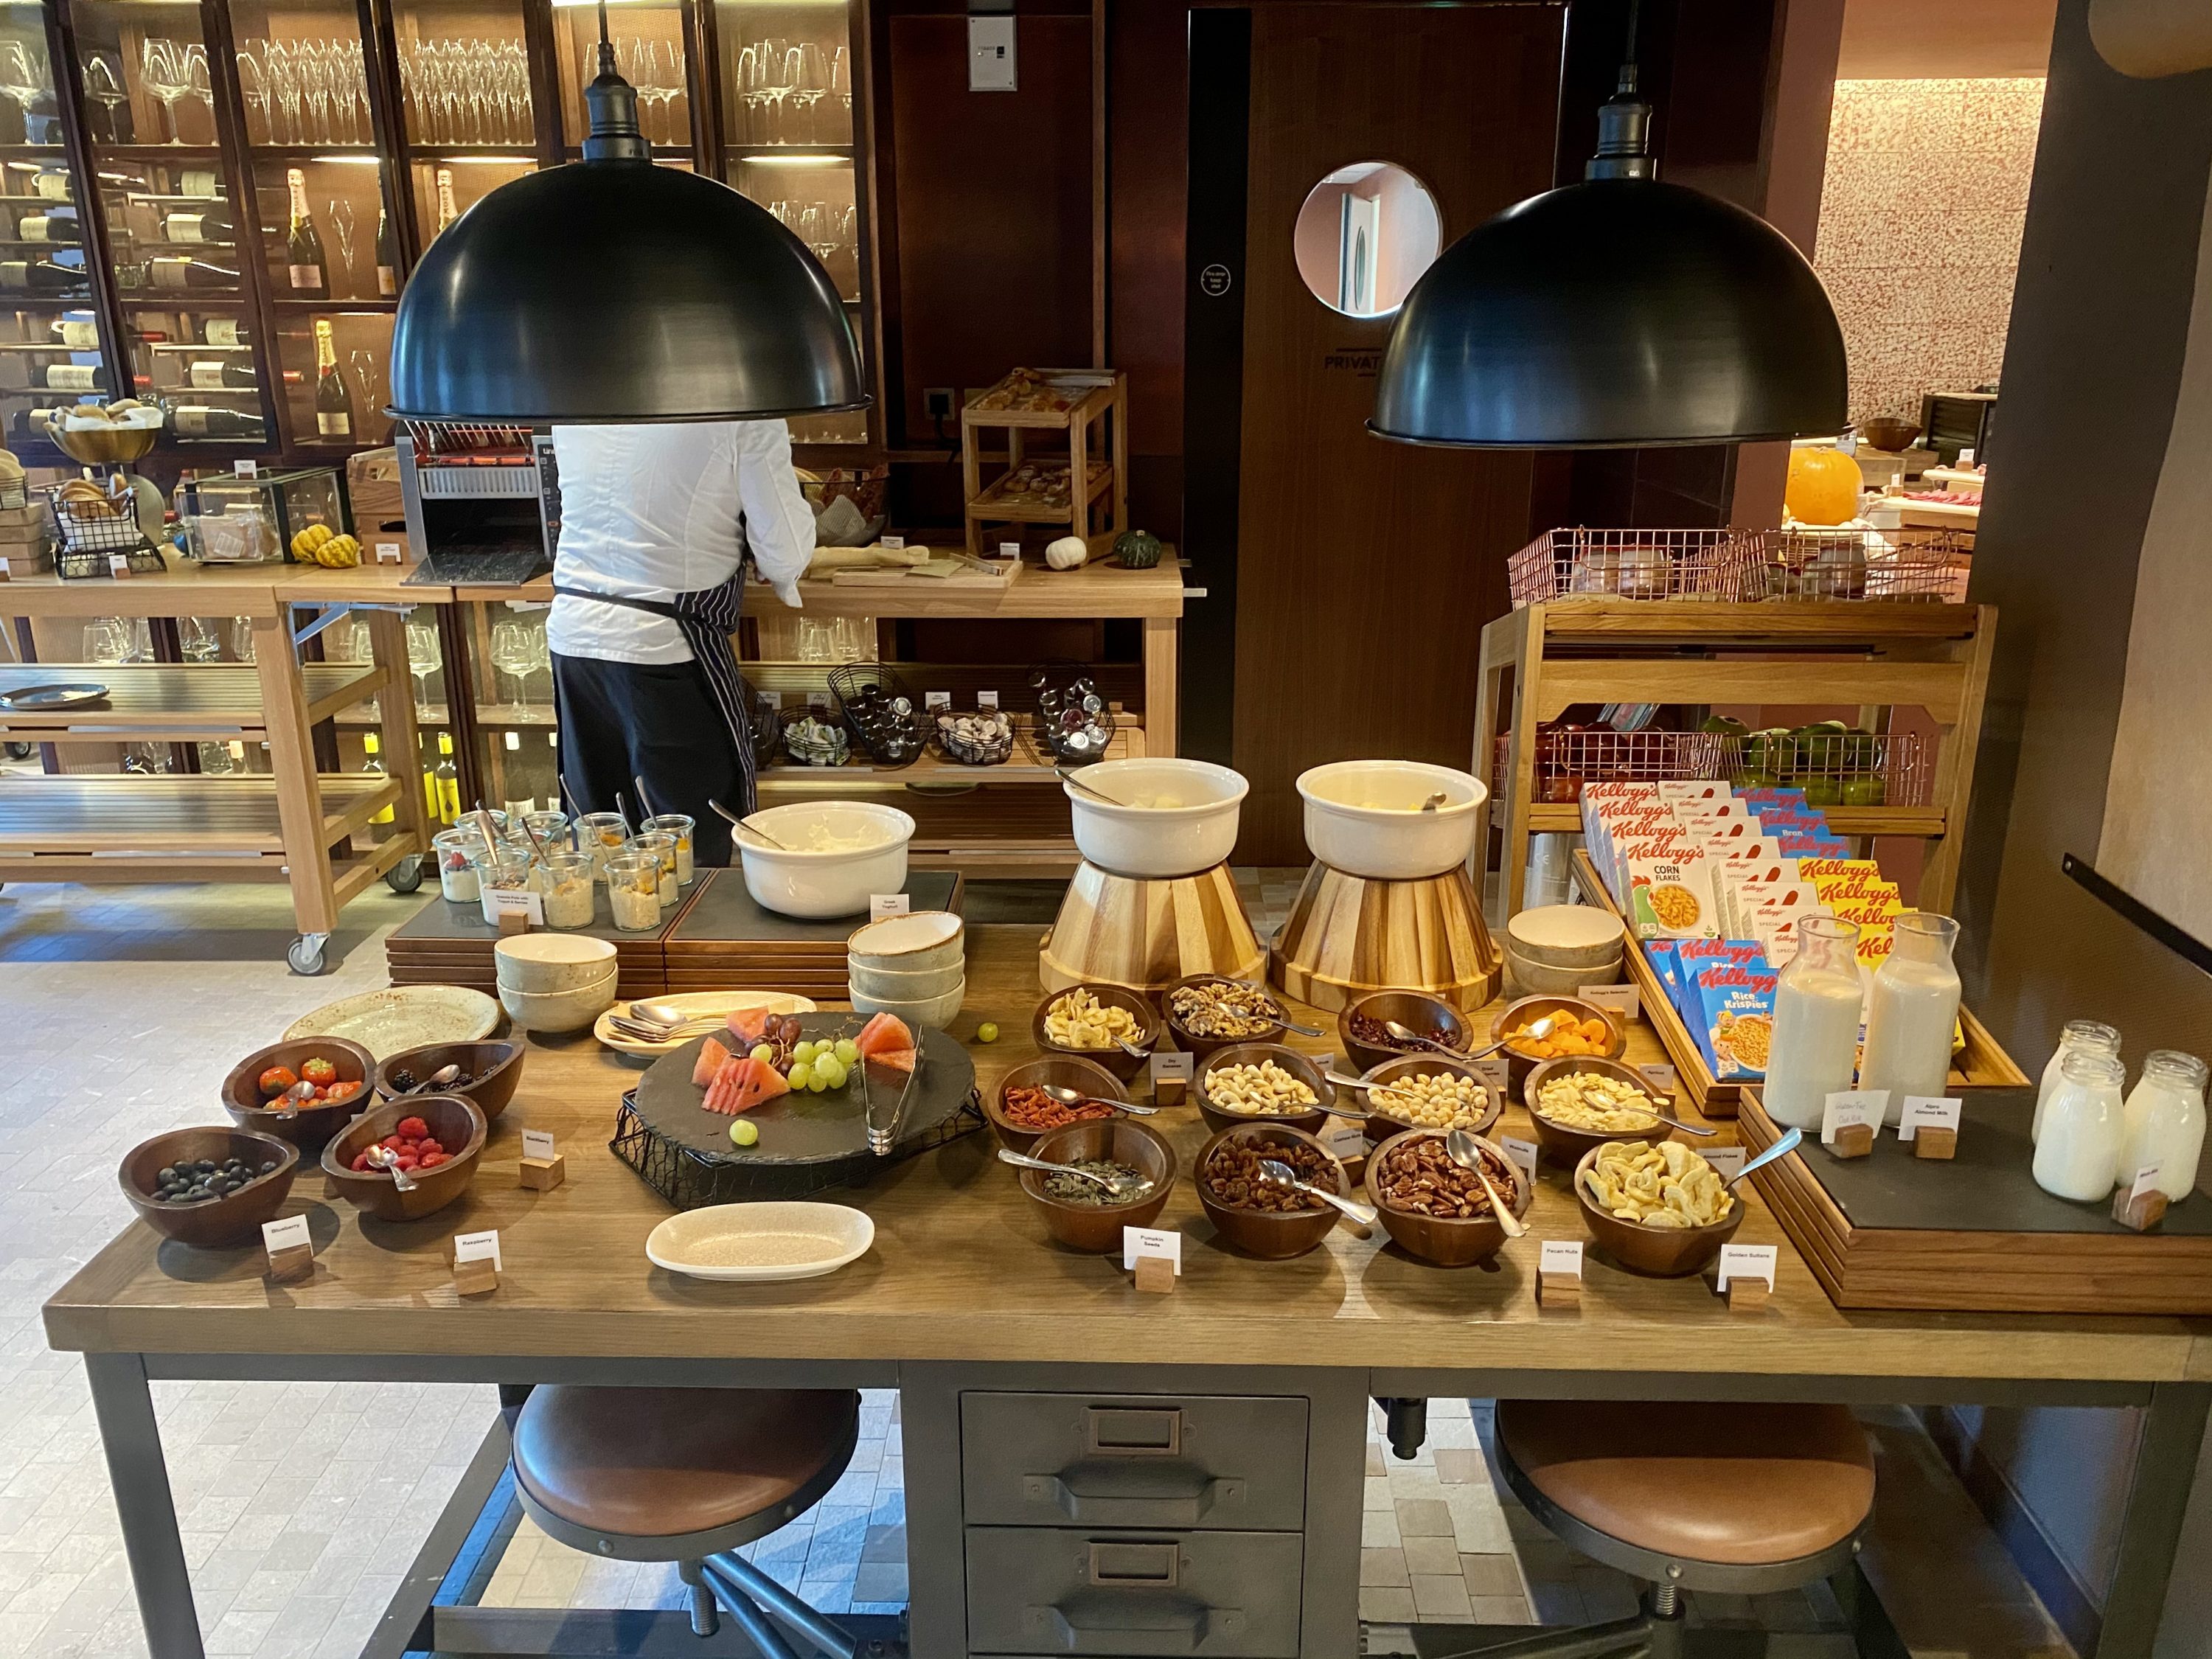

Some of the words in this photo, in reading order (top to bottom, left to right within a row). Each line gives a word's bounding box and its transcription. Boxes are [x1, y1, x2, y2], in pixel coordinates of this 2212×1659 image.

[1325, 356, 1382, 369] PRIVAT
[1586, 782, 1658, 801] Kellogg's
[1599, 800, 1672, 821] Kellogg's
[1612, 821, 1687, 842] Kellogg's
[1627, 842, 1705, 865] Kellogg's
[1654, 866, 1680, 874] CORN
[1725, 861, 1752, 869] Kellogg's
[1801, 860, 1879, 882] Kellogg's
[1819, 882, 1900, 906] Kellogg's
[1837, 908, 1896, 931] Kellog
[1775, 935, 1798, 943] Kellogg
[1680, 939, 1764, 964] Kellogg's
[1698, 968, 1779, 993] Kellogg
[1723, 1000, 1767, 1009] Krispies
[1731, 992, 1755, 1001] Rice
[462, 1238, 493, 1246] Raspberry
